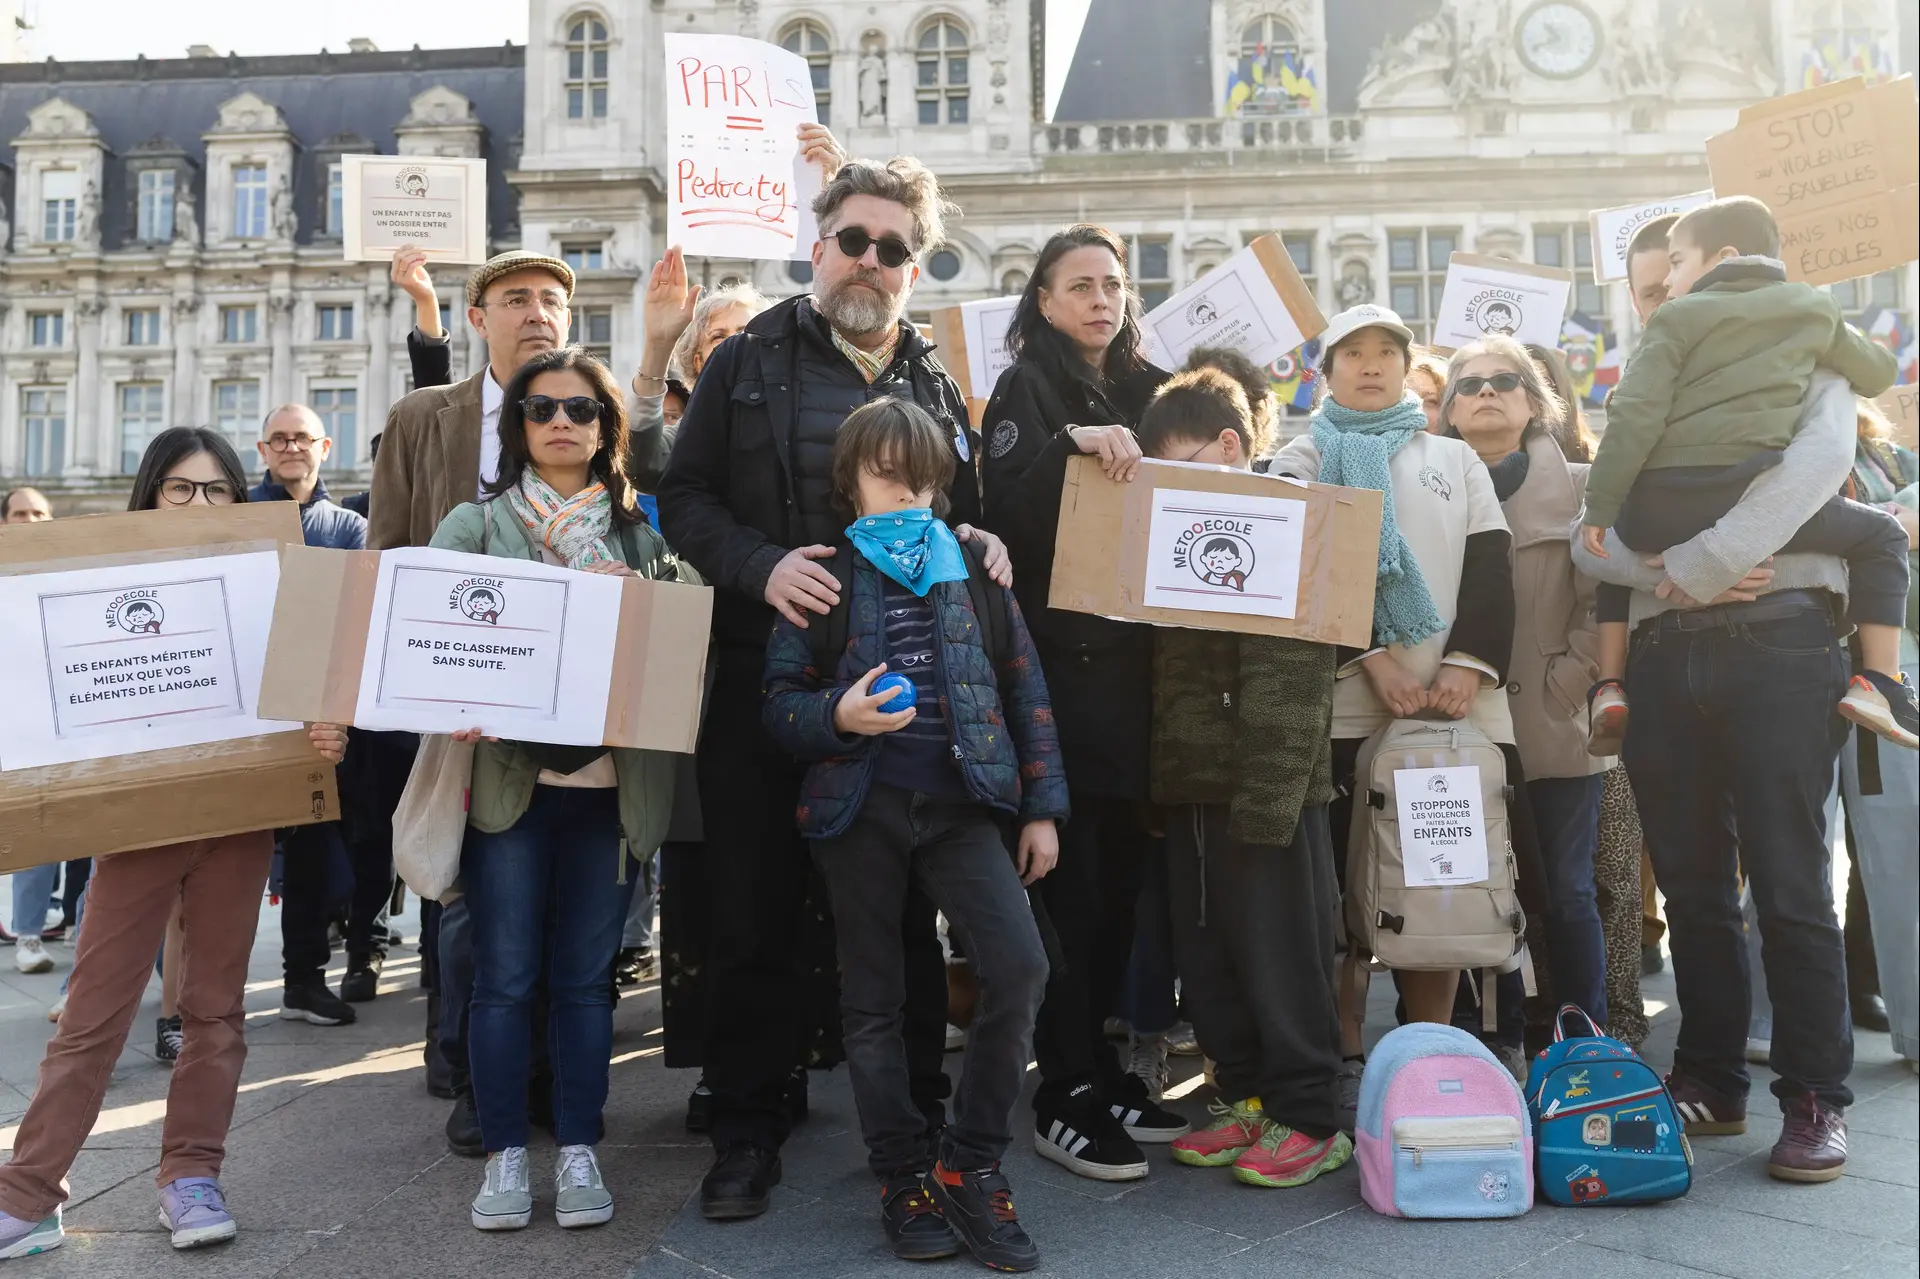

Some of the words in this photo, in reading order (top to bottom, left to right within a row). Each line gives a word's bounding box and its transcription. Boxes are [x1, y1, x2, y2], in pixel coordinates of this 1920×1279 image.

[1768, 101, 1854, 151] STOP
[1777, 137, 1876, 177] VIOLENCES
[678, 158, 797, 222] Pedocity
[1774, 164, 1877, 207] SEXUELLES
[389, 220, 421, 228] DOSSIER
[1838, 213, 1879, 234] NOS
[1800, 239, 1882, 275] ÉCOLES
[1465, 289, 1524, 322] METOOECOLE
[1224, 319, 1239, 332] PLUS
[1240, 322, 1252, 331] ON
[1173, 519, 1253, 569] METOOECOLE
[449, 577, 505, 610] METOOECOLE
[105, 589, 158, 628] METOOECOLE
[65, 662, 88, 674] LES
[91, 655, 148, 671] ENFANTS
[151, 647, 213, 664] MÉRITENT
[407, 638, 431, 649] PAS
[434, 640, 450, 650] DE
[453, 642, 535, 657] CLASSEMENT
[93, 674, 134, 686] MIEUX
[137, 668, 163, 681] QUE
[165, 665, 191, 676] VOS
[432, 655, 466, 667] SANS
[468, 658, 506, 671] SUITE.
[69, 687, 136, 705] ÉLÉMENTS
[139, 684, 156, 695] DE
[158, 676, 218, 693] LANGAGE
[1411, 799, 1470, 811] STOPPONS
[1412, 812, 1426, 820] LES
[1427, 810, 1471, 819] VIOLENCES
[1413, 826, 1472, 839] ENFANTS
